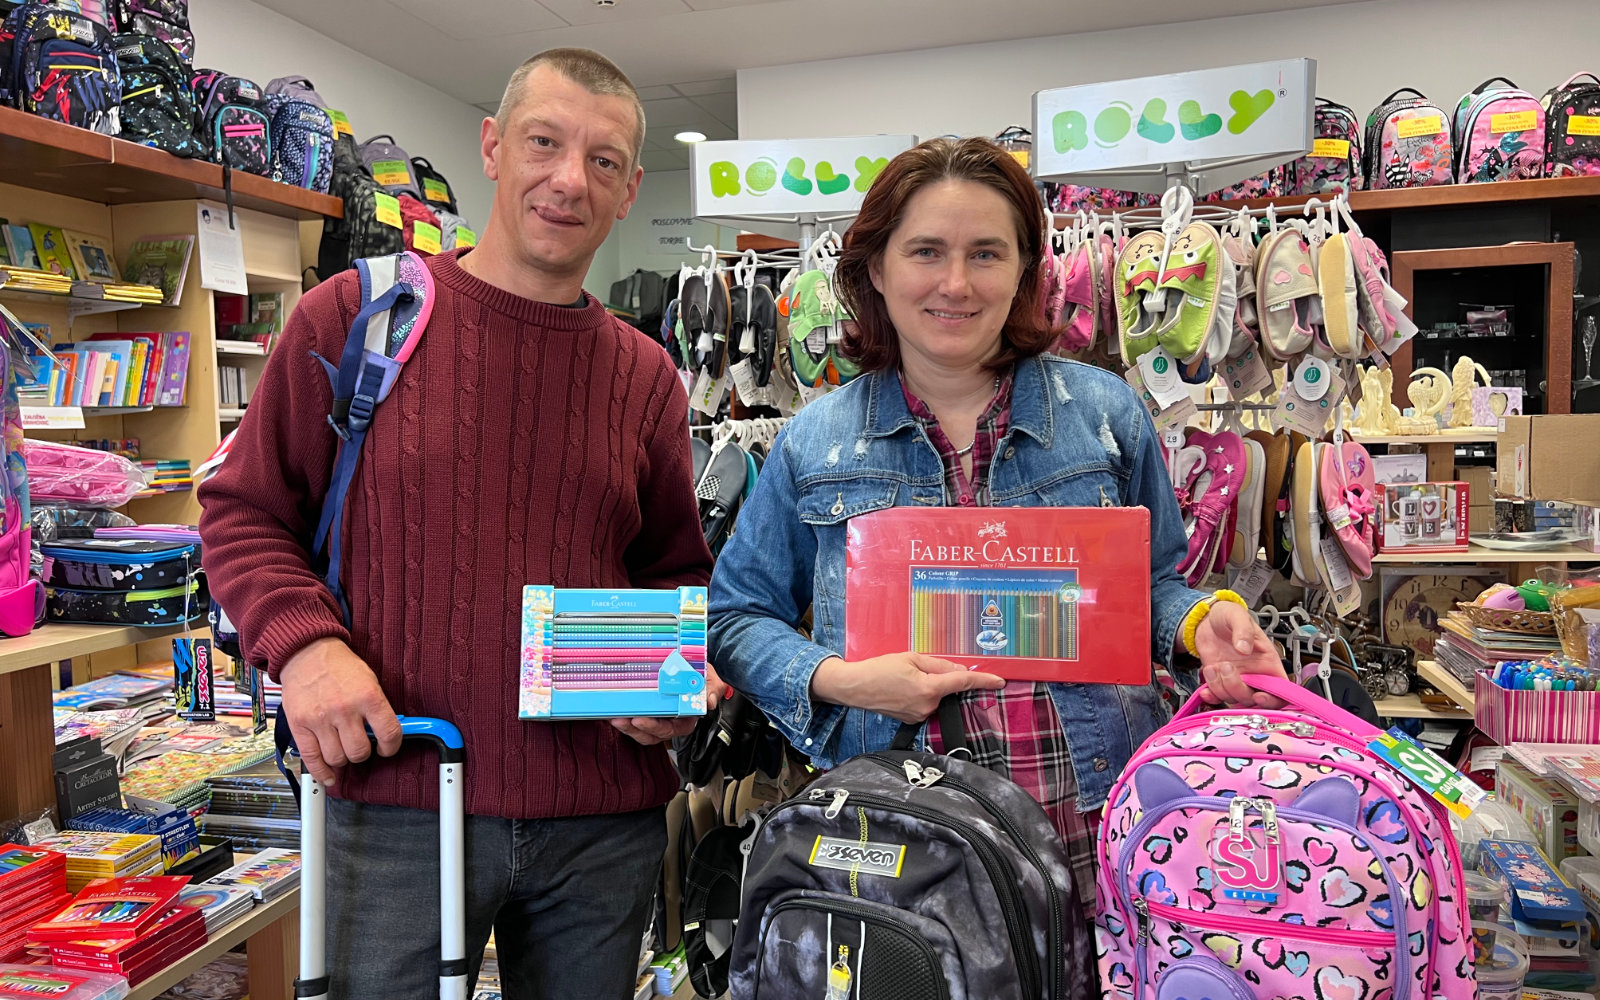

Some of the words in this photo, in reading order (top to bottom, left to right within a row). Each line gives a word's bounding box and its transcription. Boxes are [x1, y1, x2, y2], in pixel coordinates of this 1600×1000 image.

[1052, 89, 1275, 155] ROLLY
[709, 156, 890, 198] ROLLY
[909, 540, 1079, 563] FABER-CASTELL
[914, 570, 927, 581] 36
[1433, 575, 1448, 587] 12
[591, 599, 637, 608] FABER-CASTELL
[1394, 598, 1408, 611] 10
[1389, 619, 1400, 633] 9
[76, 800, 97, 813] ARTIST
[97, 792, 118, 805] STUDIO
